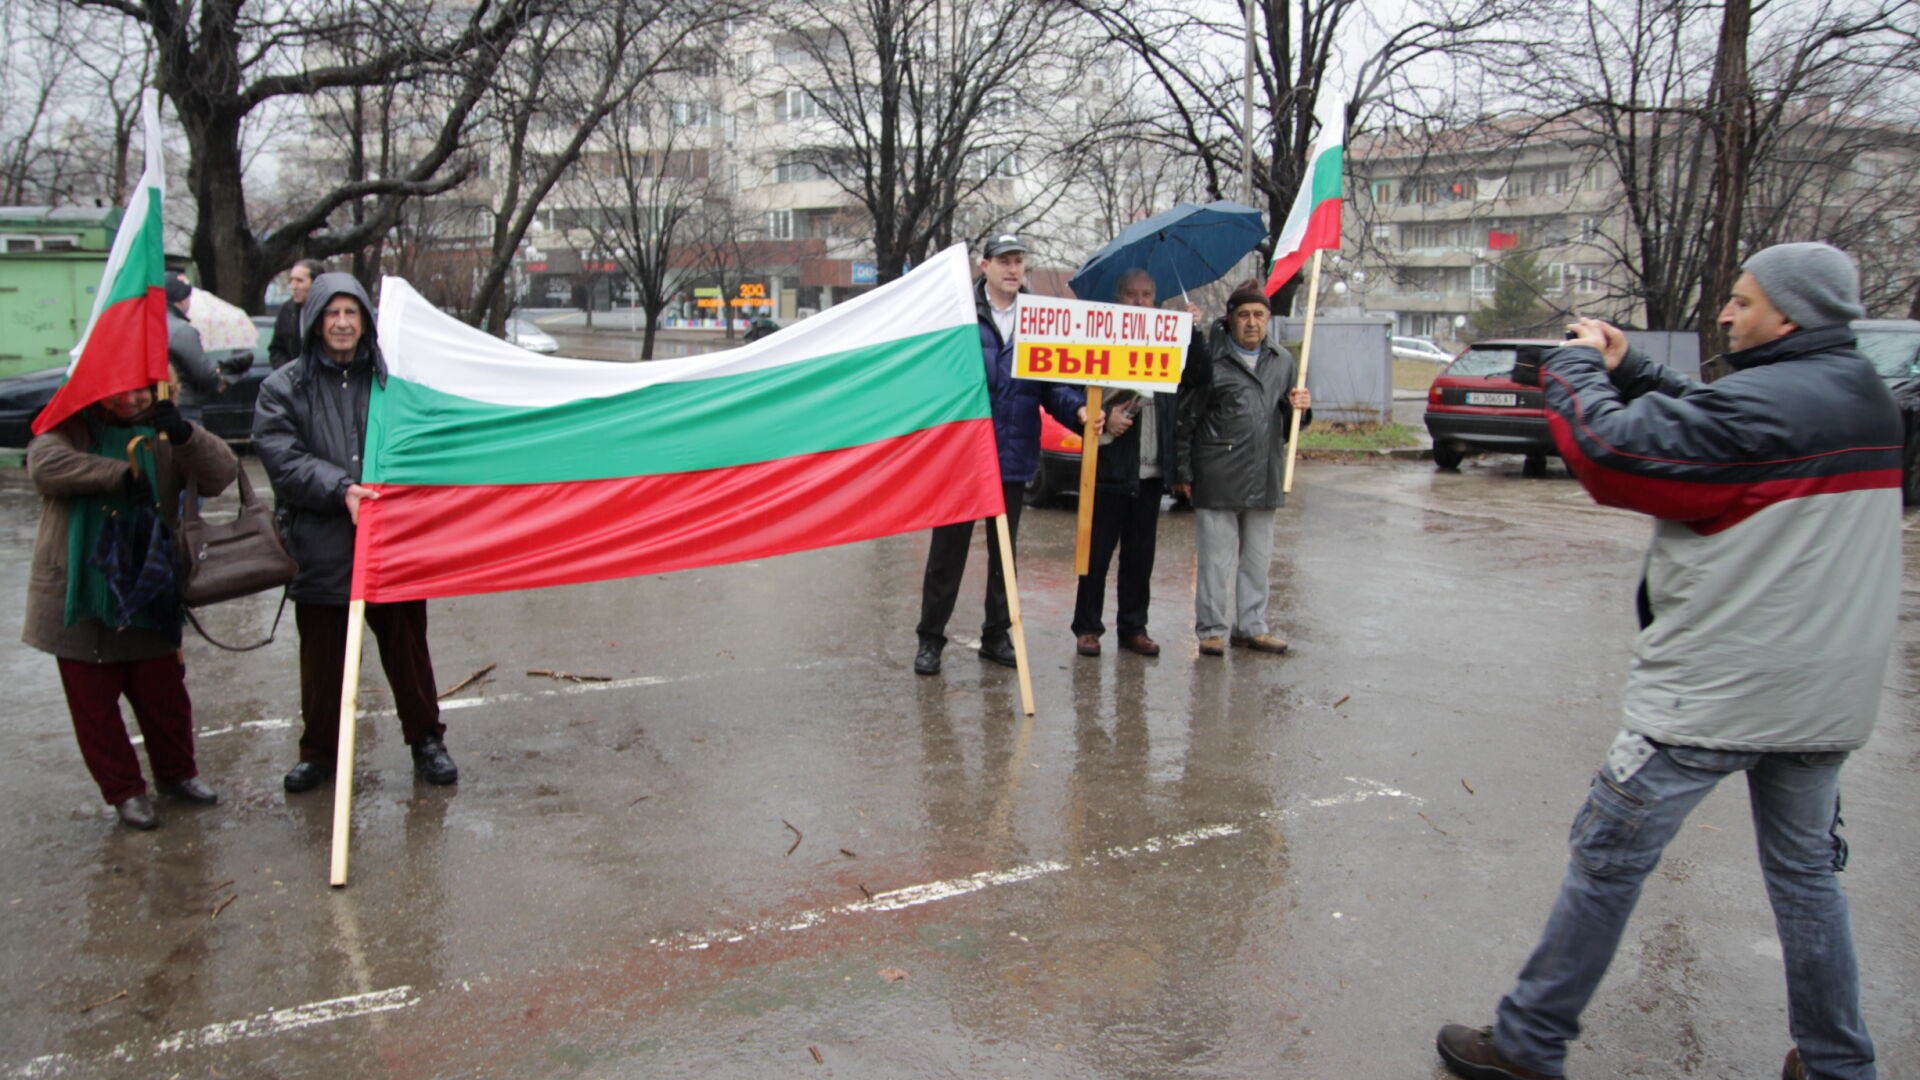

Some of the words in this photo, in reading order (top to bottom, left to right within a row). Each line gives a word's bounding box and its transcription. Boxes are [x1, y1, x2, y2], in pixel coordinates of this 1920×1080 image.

[739, 284, 764, 297] 200
[1020, 306, 1071, 336] ЕНЕРГО
[1086, 310, 1117, 344] ПРО,
[1122, 312, 1150, 345] EVN,
[1155, 314, 1179, 342] CEZ
[1029, 346, 1110, 375] ВЪН
